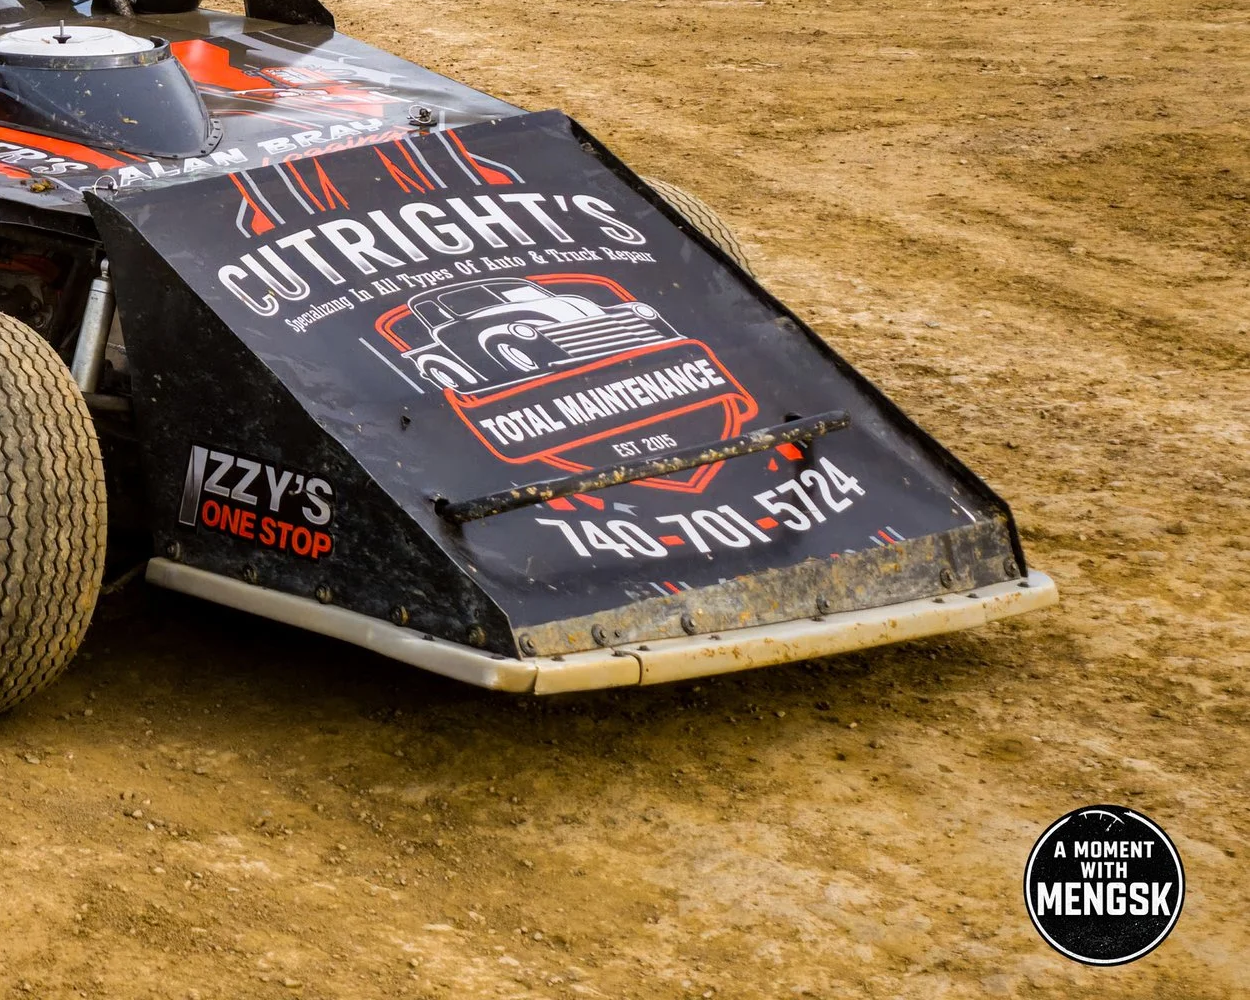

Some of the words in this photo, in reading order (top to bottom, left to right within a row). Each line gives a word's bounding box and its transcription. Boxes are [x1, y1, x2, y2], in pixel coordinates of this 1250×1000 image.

[116, 147, 249, 188] ALAN
[257, 117, 383, 155] BRAY
[217, 192, 647, 318] CUTRIGHT'S
[285, 295, 355, 333] Specializing
[348, 288, 374, 302] In
[371, 278, 402, 296] All
[396, 266, 455, 288] Types
[454, 259, 482, 275] Of
[480, 256, 526, 271] Auto
[528, 250, 549, 265] &
[544, 247, 603, 263] Truck
[598, 246, 657, 264] Repair
[479, 404, 567, 445] TOTAL
[552, 358, 726, 425] MAINTENANCE
[178, 445, 333, 526] IZZY'S
[612, 440, 639, 458] EST
[641, 433, 678, 453] 2015
[202, 500, 257, 540] ONE
[258, 516, 333, 560] STOP
[534, 456, 867, 559] 740-701-5724
